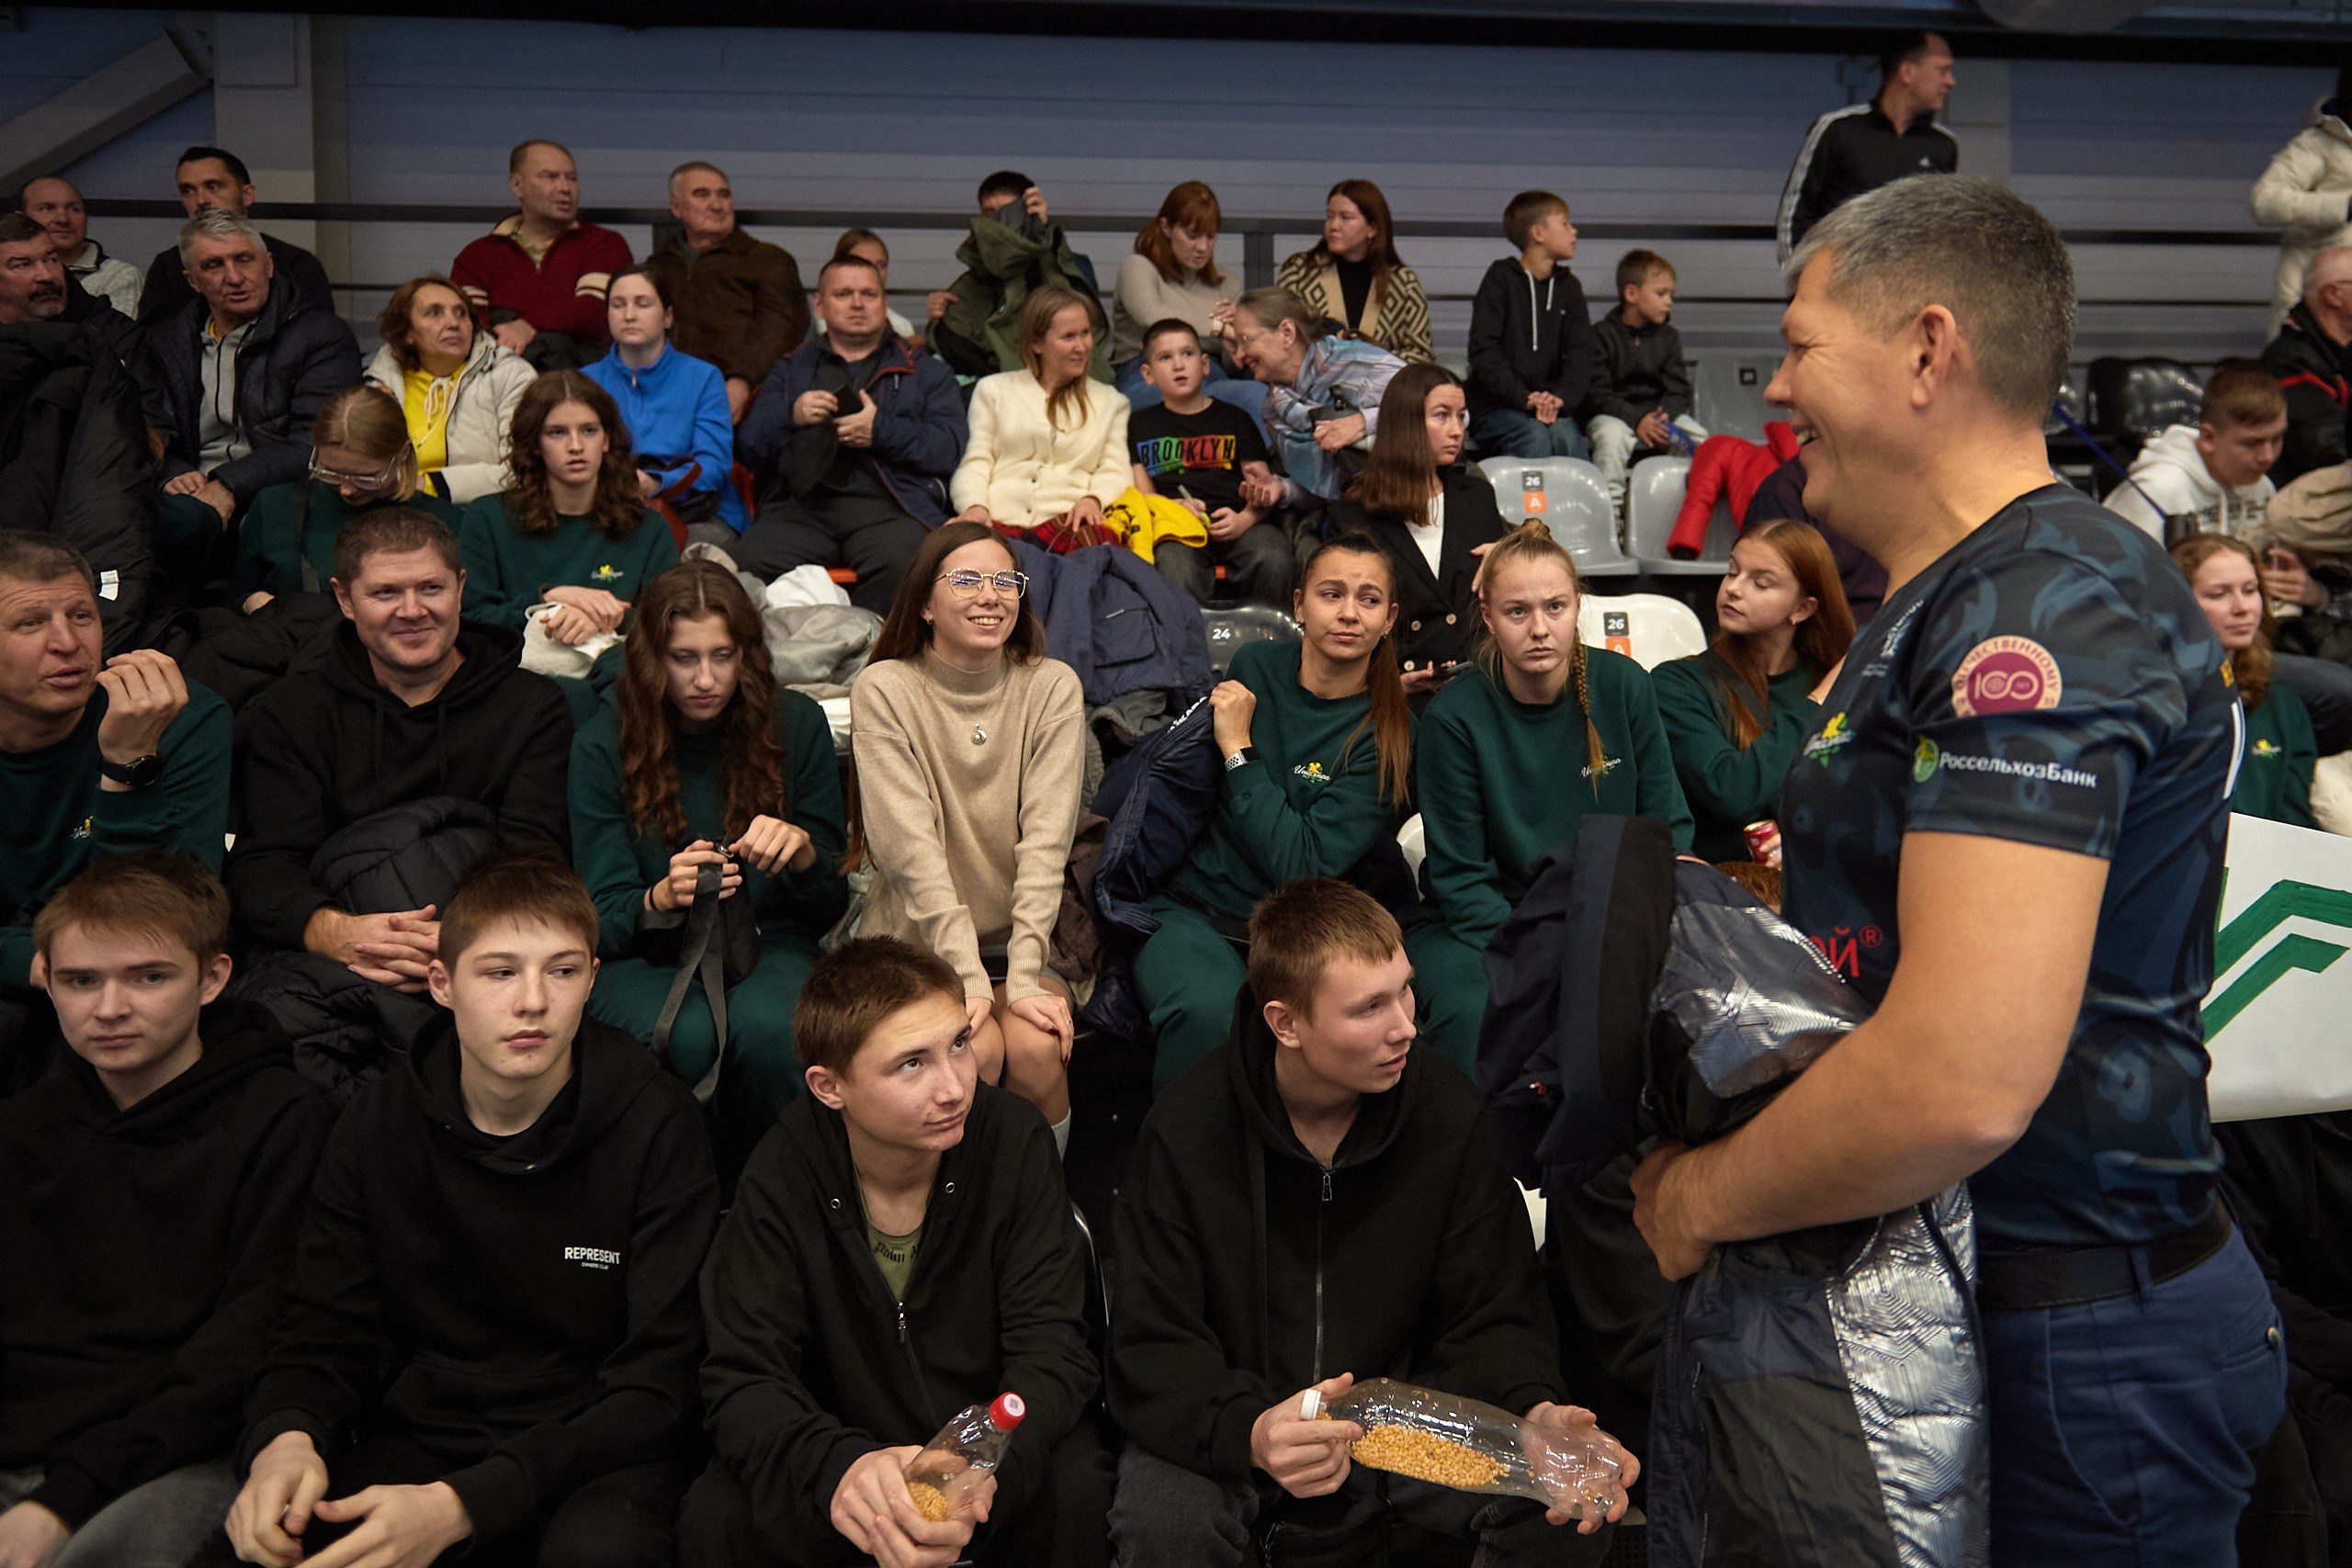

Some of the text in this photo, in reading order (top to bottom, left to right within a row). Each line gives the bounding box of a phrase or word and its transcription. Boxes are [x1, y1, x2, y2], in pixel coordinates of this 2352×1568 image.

[1140, 438, 1234, 467] BROOKLYN
[1525, 476, 1540, 486] 26
[1608, 618, 1624, 629] 26
[1212, 627, 1231, 639] 24
[1939, 750, 2098, 788] РоссельхозБанк
[564, 1246, 621, 1265] REPRESENT
